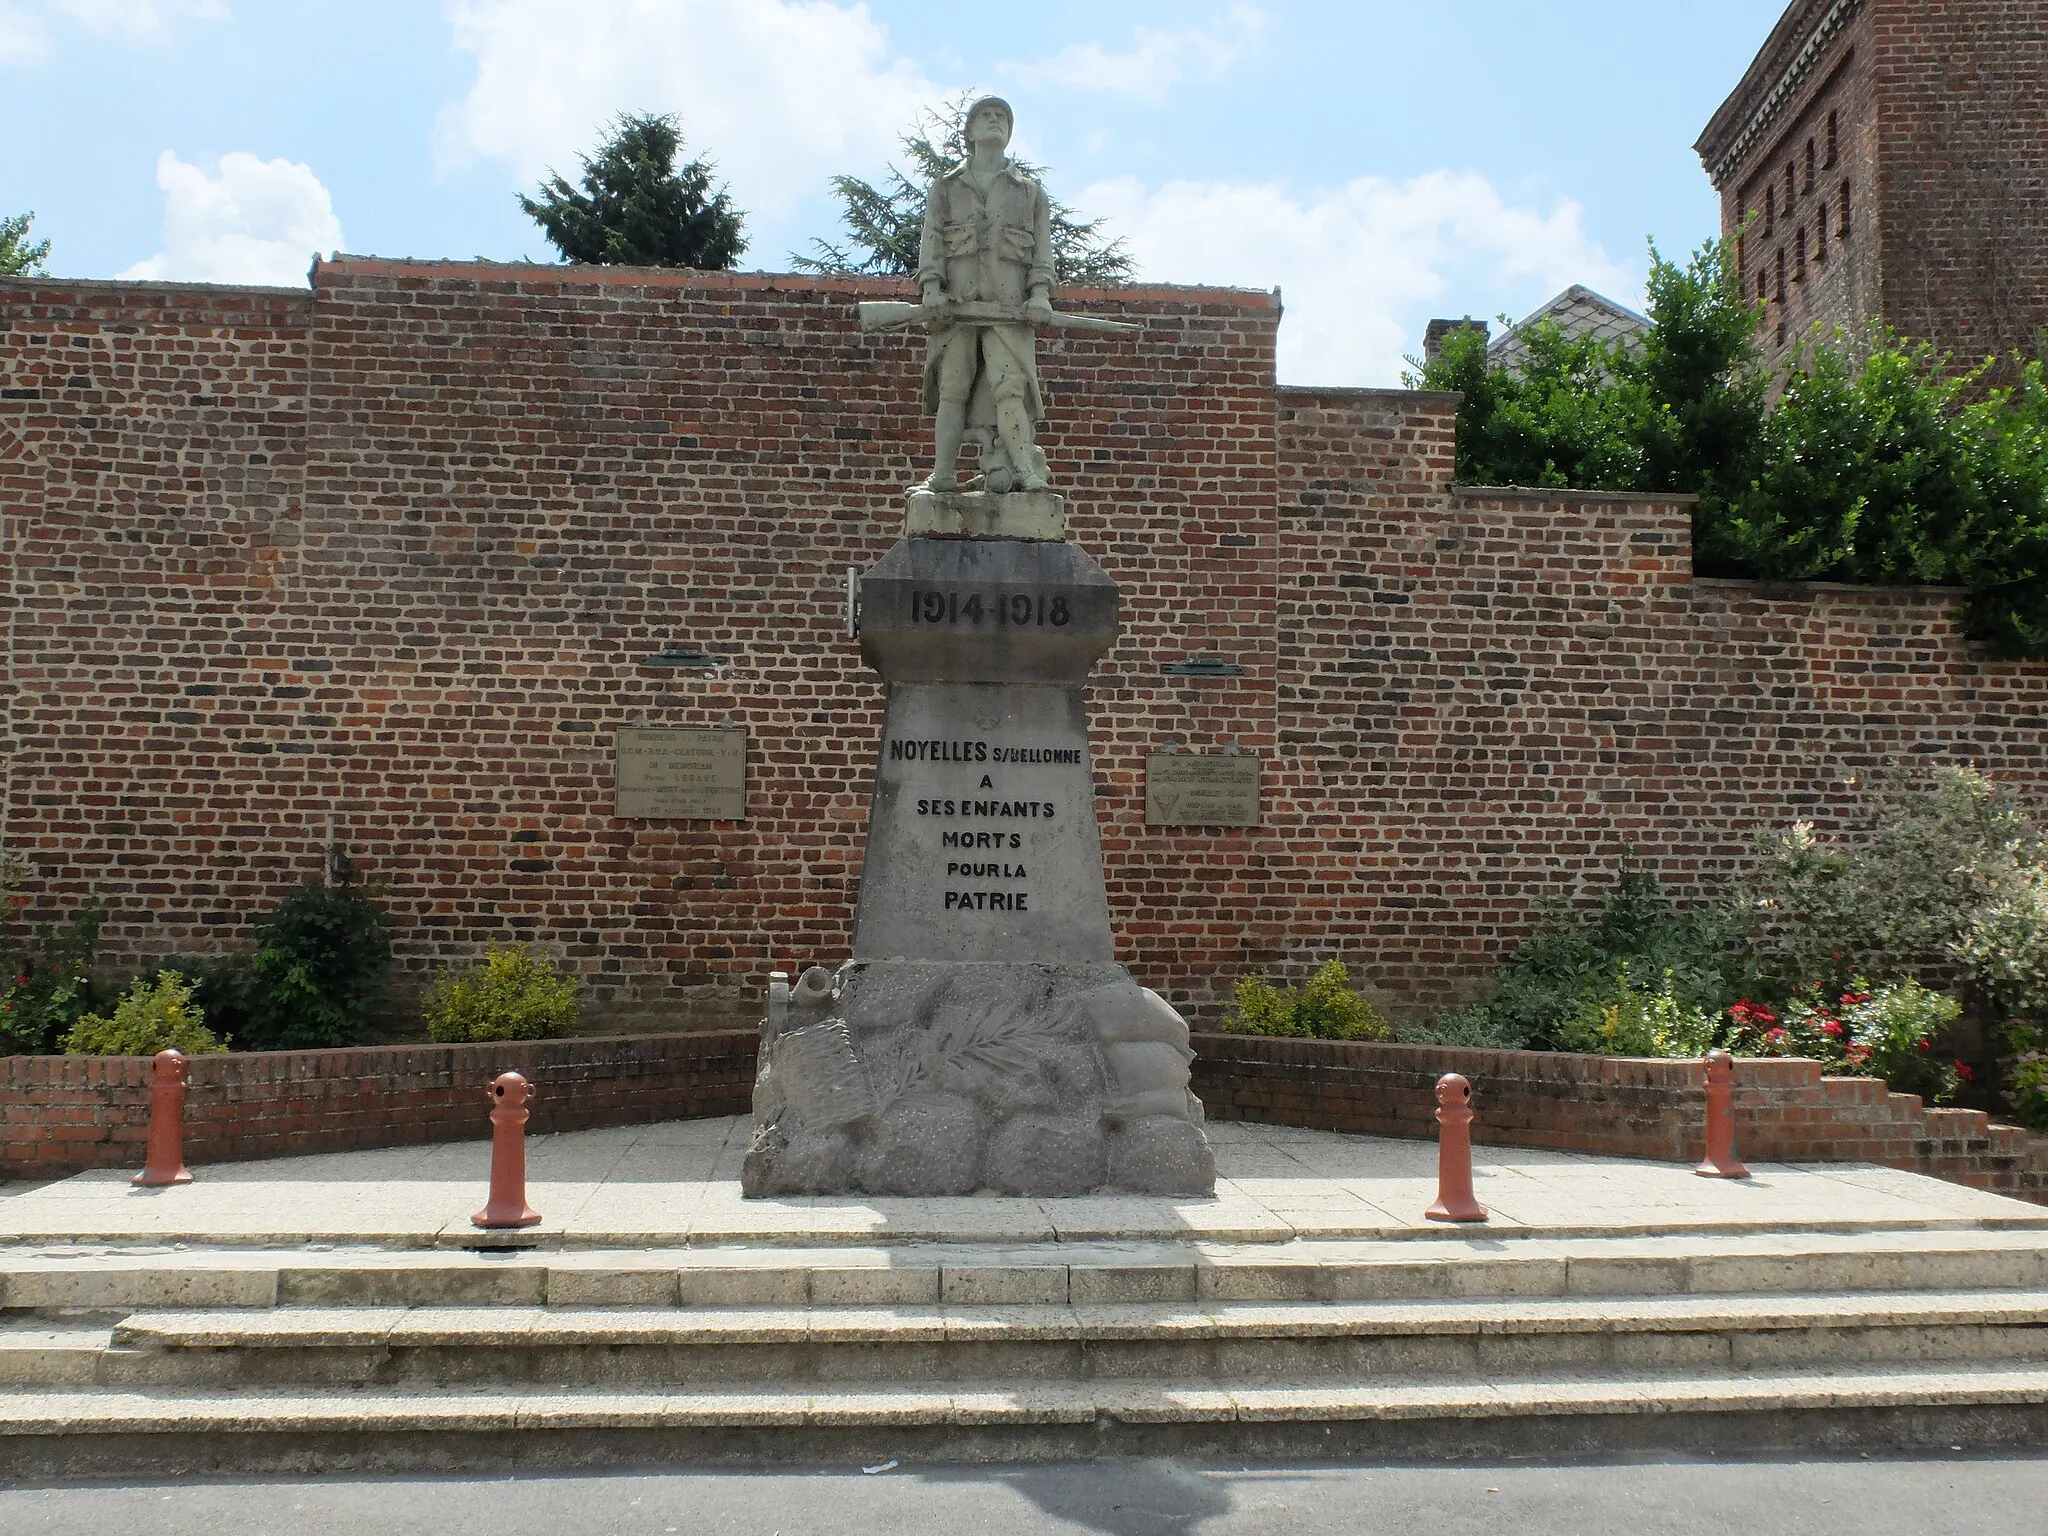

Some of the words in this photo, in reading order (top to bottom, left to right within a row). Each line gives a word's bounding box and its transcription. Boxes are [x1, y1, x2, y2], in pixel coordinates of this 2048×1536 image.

[911, 589, 1071, 627] 1914-1918
[889, 740, 987, 762] NOYELLES
[992, 748, 1082, 764] S/BELLONNE
[980, 774, 993, 788] A
[917, 799, 955, 816] SES
[961, 801, 1055, 817] ENFANTS
[943, 831, 1022, 849] MORTS
[947, 863, 1000, 877] POUR
[1004, 863, 1027, 878] LA
[944, 891, 1028, 911] PATRIE
